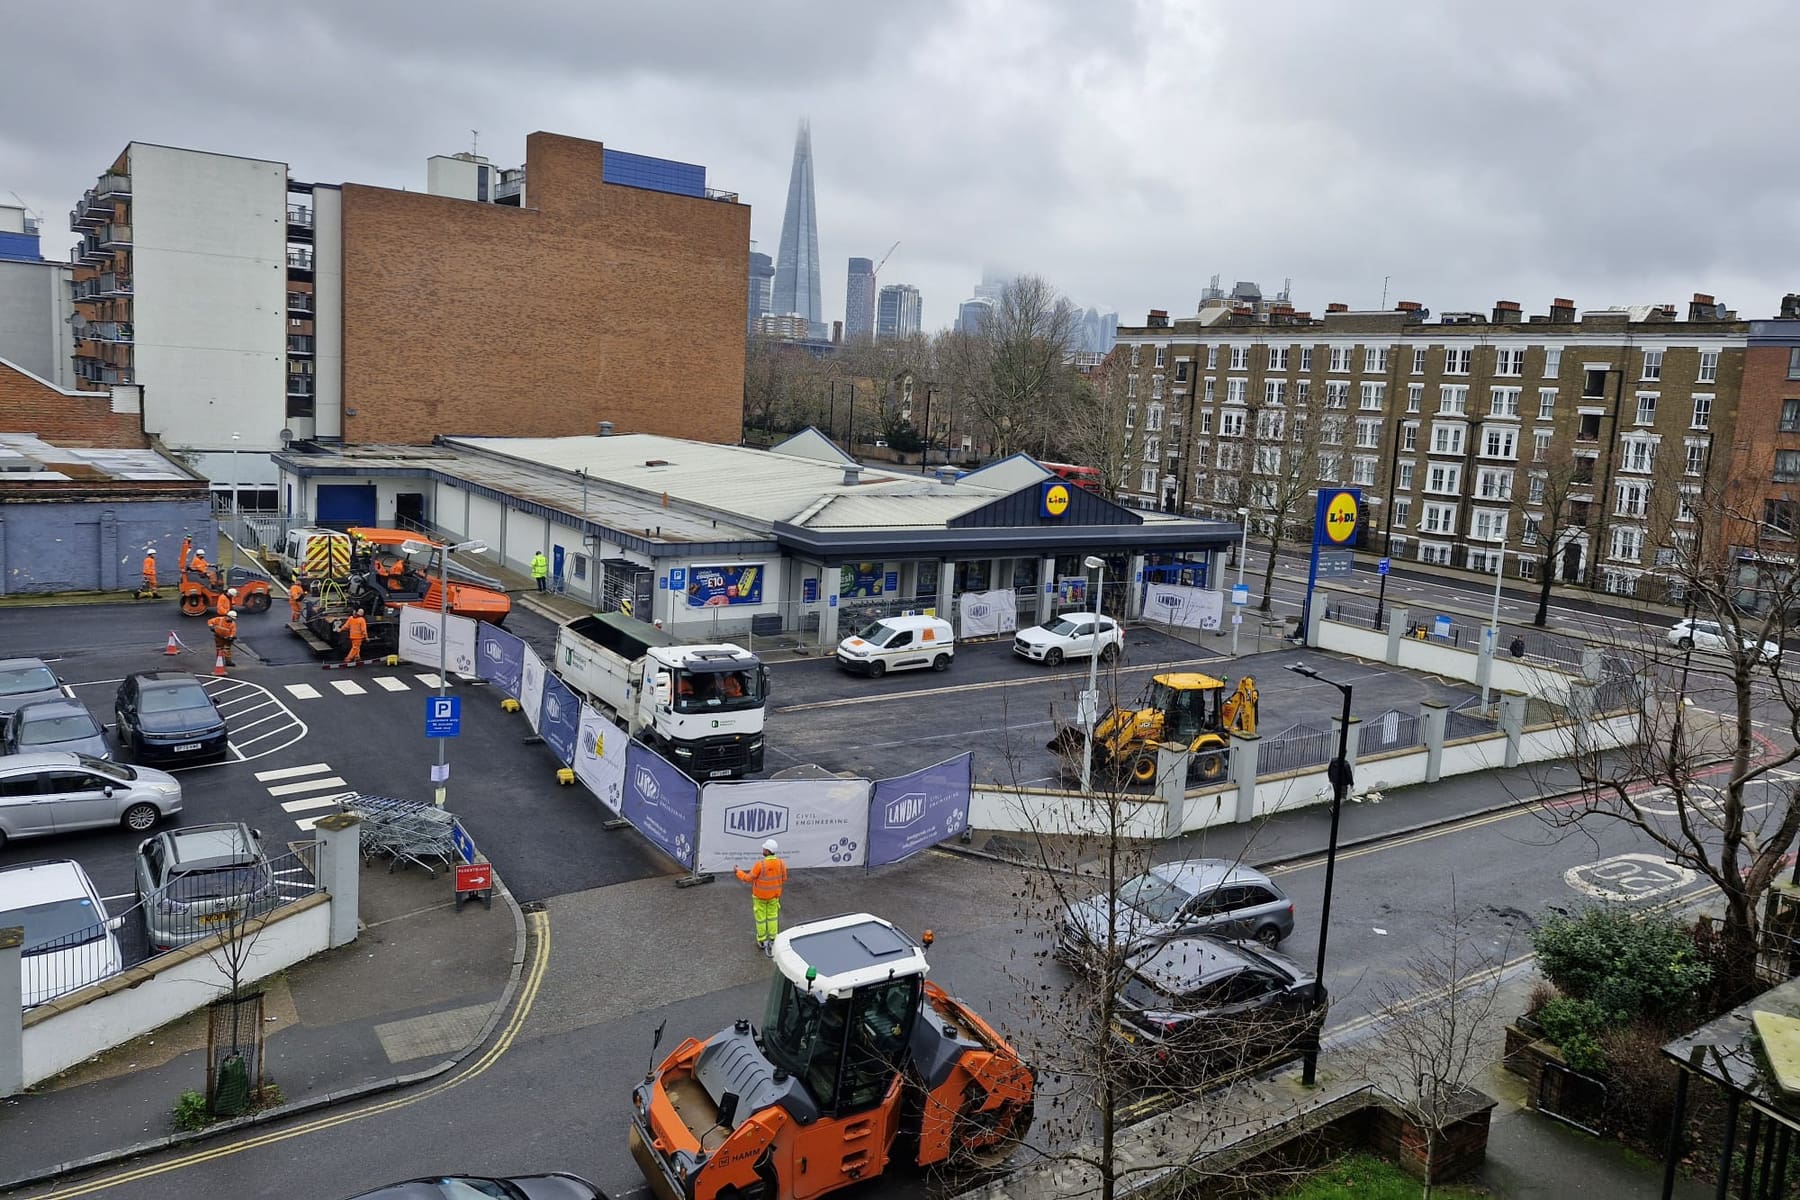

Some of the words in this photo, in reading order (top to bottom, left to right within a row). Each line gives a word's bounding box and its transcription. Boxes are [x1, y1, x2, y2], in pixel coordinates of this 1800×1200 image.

[707, 577, 724, 588] £10
[1157, 595, 1182, 607] LAWDAY
[411, 625, 436, 641] LAWDAY
[438, 703, 449, 716] P
[888, 798, 923, 824] LAWDAY
[730, 808, 783, 833] LAWDAY
[795, 818, 849, 826] ENGINEERING
[1590, 861, 1675, 891] 20
[731, 1148, 761, 1162] HAMM
